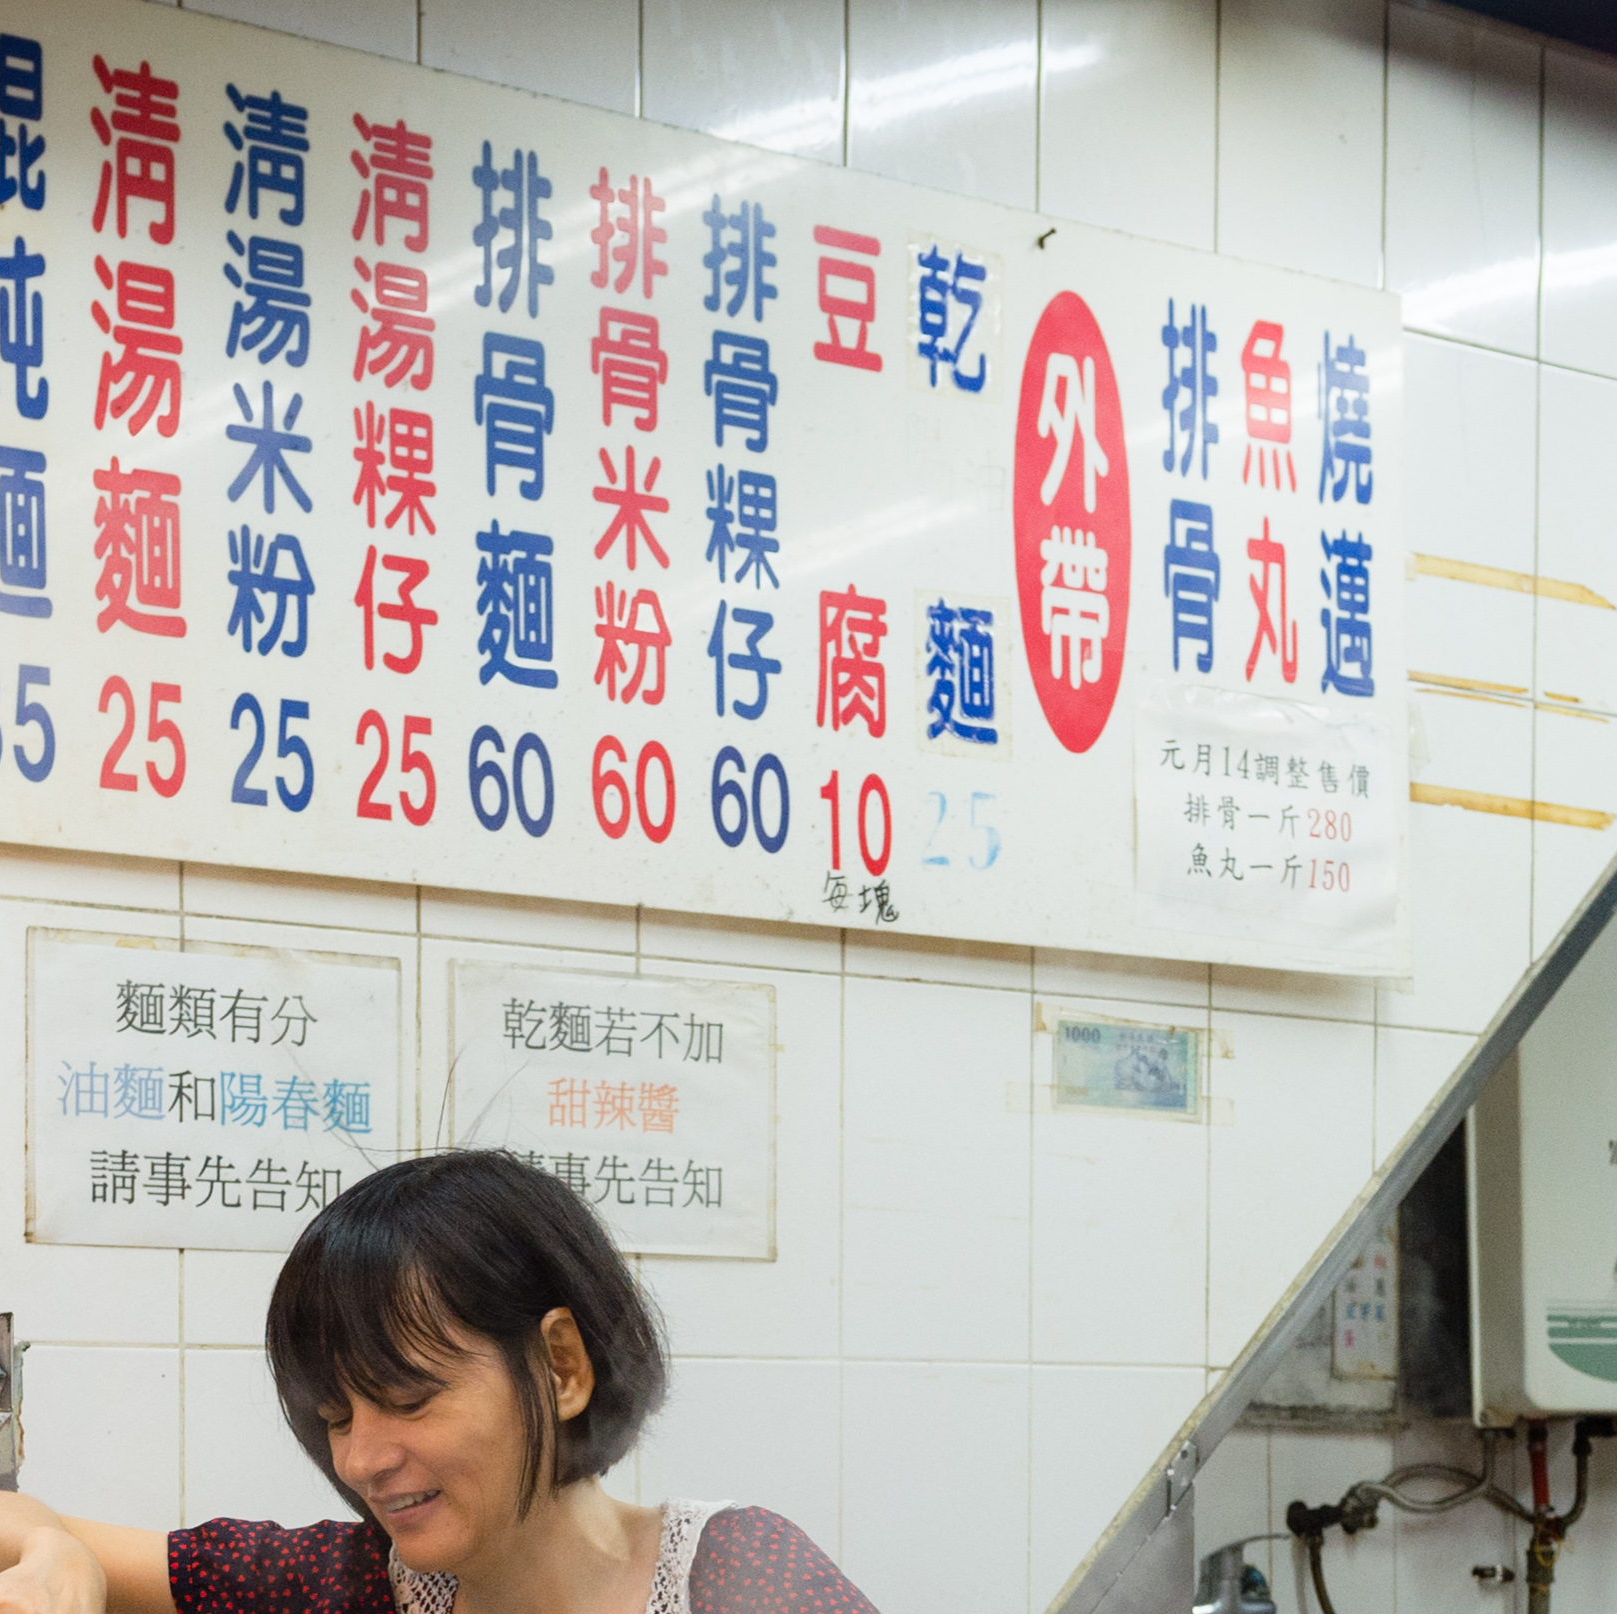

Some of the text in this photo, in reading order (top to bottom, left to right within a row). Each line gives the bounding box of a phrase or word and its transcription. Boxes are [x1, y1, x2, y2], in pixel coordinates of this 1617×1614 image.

[89, 52, 188, 799] 清湯麵 25
[224, 87, 315, 812] 清湯米粉 25
[349, 111, 439, 827] 清湯粿仔 25
[469, 143, 558, 836] 排骨麵 60
[590, 167, 677, 844] 排骨米粉 60
[700, 189, 789, 852] 排骨粿仔 60
[1037, 352, 1111, 690] 外帶
[1160, 297, 1221, 673] 排骨
[1239, 317, 1298, 684] 魚丸
[1318, 331, 1374, 697] 燒邁
[818, 767, 893, 877] 10
[922, 791, 1002, 870] 25
[56, 1058, 374, 1135] 油麵和陽春麵
[89, 1149, 343, 1214] 請事先告知
[115, 979, 318, 1047] 麵類有分
[502, 997, 724, 1064] 乾麵若不加
[547, 1076, 680, 1135] 甜辣醬
[1064, 1025, 1102, 1044] 1000
